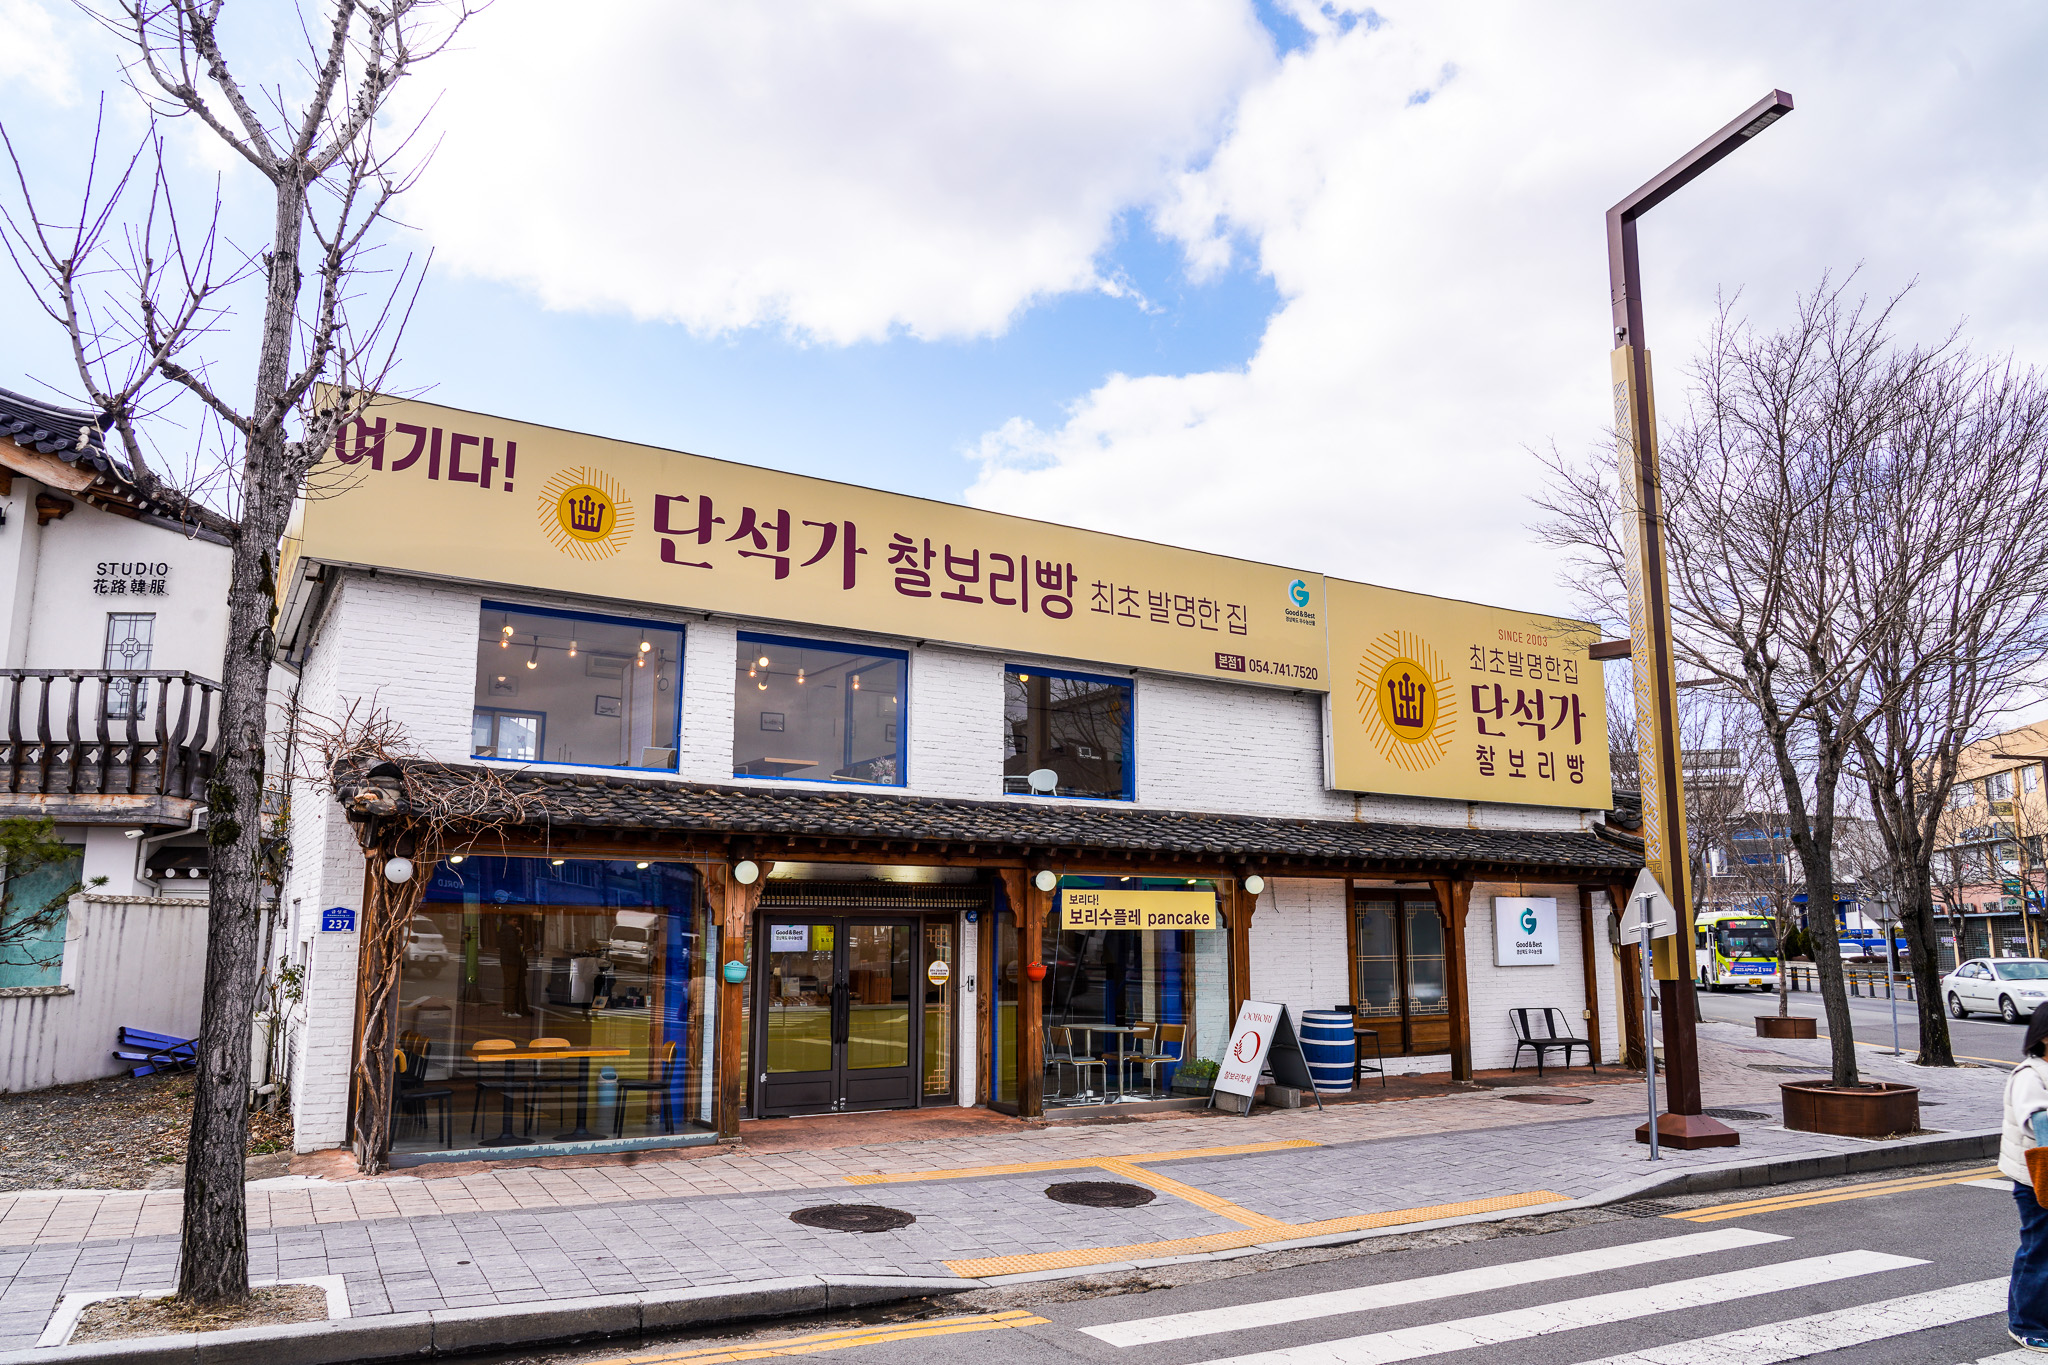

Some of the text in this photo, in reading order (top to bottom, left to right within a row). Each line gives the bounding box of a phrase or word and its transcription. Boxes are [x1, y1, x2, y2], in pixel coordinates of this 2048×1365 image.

[335, 413, 517, 493] 여기다!
[96, 562, 168, 576] STUDIO
[653, 494, 1247, 636] 단석가 찰보리빵 최초 발명한 집
[93, 578, 166, 594] 花路韓服
[1498, 629, 1548, 647] SINCE 2003
[1218, 654, 1319, 681] 본점1 054.741.7520
[1469, 644, 1579, 685] 최초발명한집
[1471, 683, 1587, 745] 단석가
[1069, 894, 1099, 905] 보리다!
[328, 919, 350, 929] 237
[1069, 908, 1210, 927] 보리수플레 pancake
